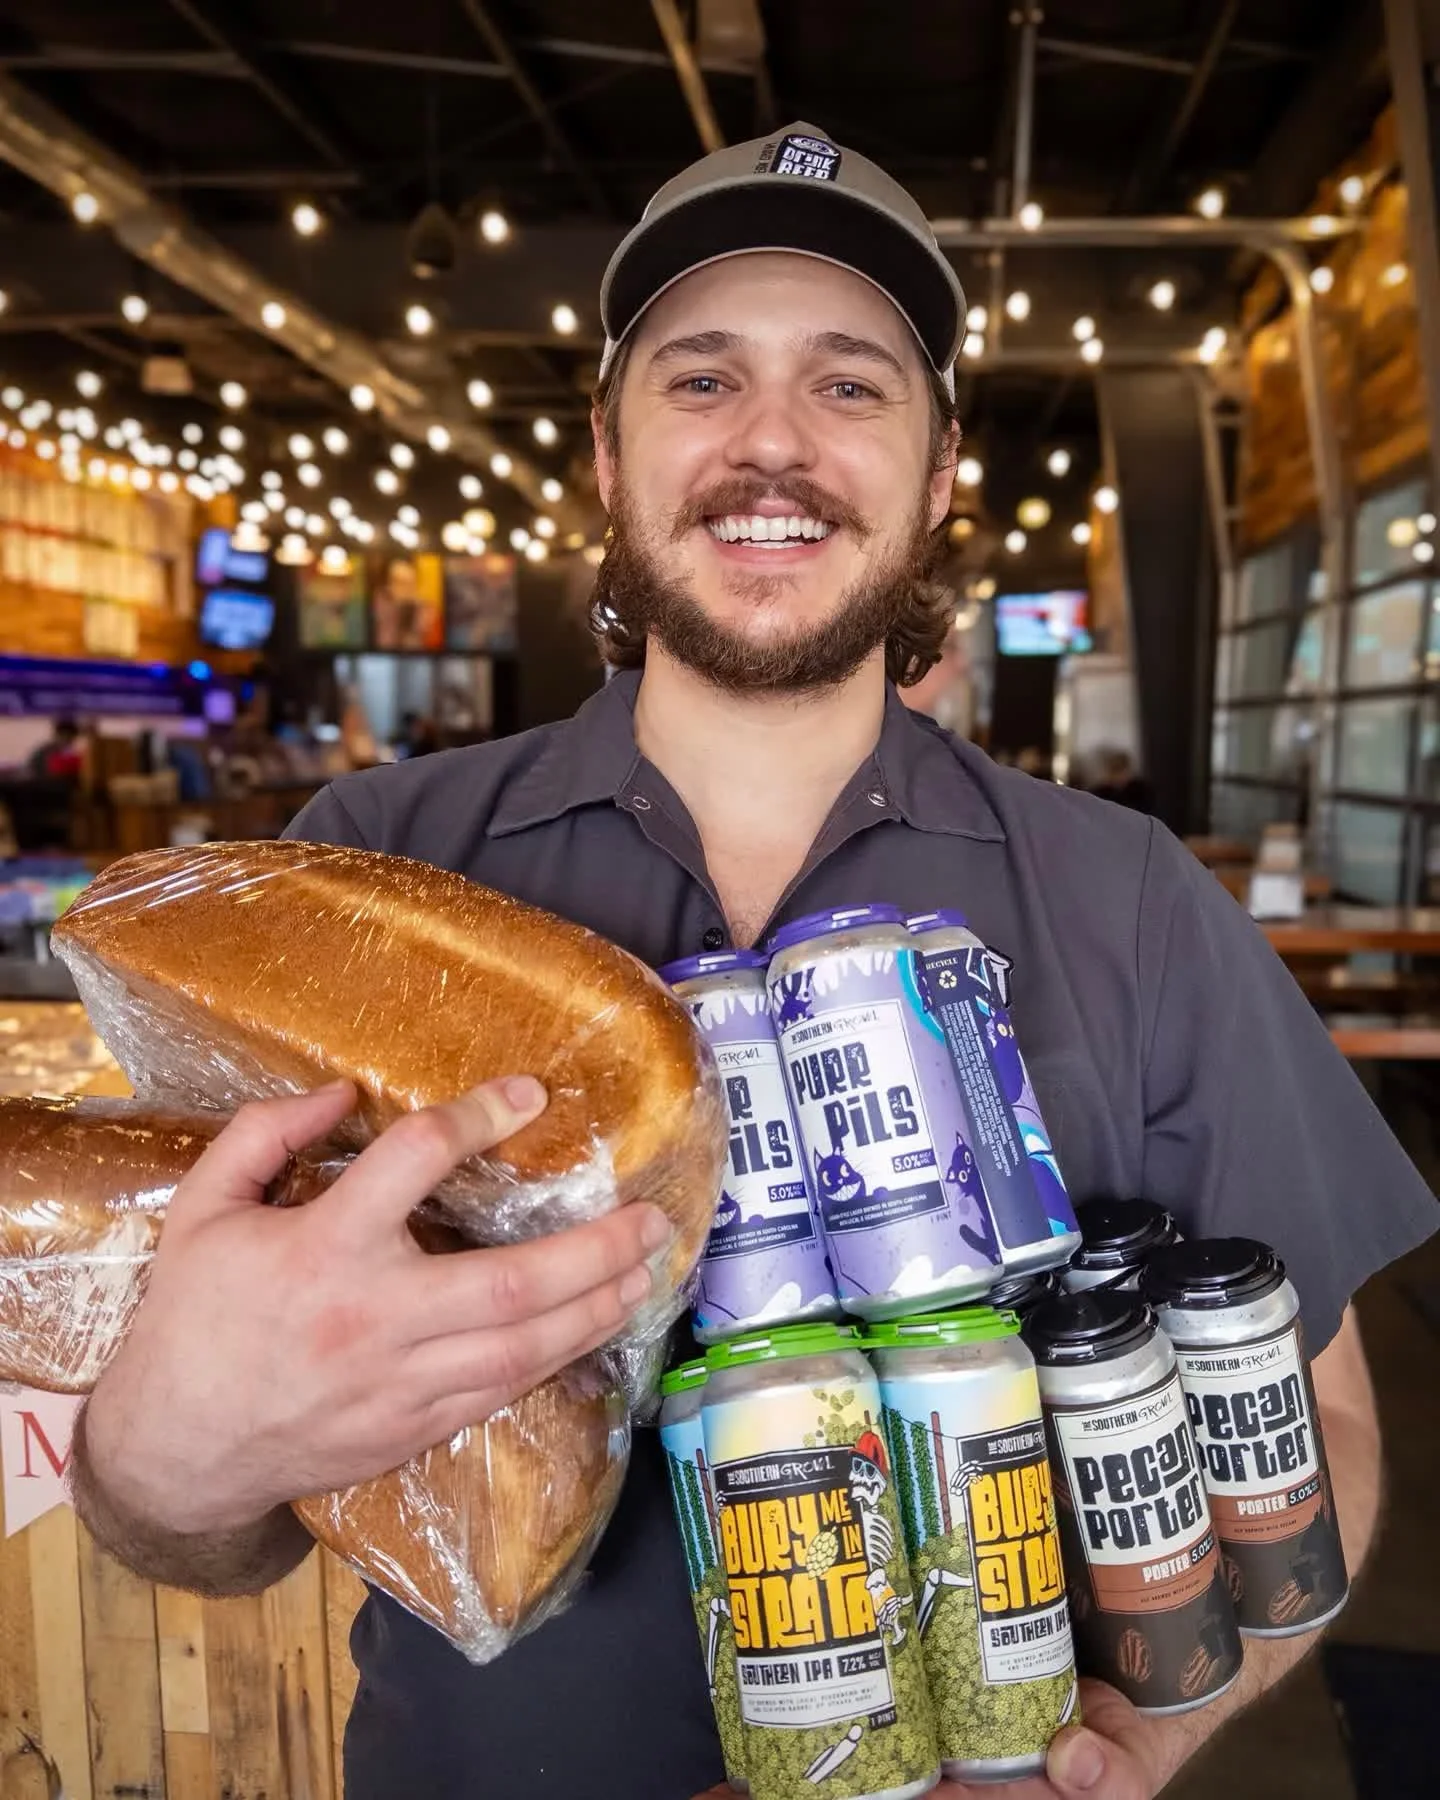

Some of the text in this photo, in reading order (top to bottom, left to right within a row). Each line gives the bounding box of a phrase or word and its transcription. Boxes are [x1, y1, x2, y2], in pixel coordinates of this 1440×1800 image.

[925, 957, 958, 971] RECYCLE
[796, 1021, 833, 1043] SOUTHERN
[789, 1041, 873, 1106] PURR
[894, 1153, 921, 1171] 5.0%
[770, 1187, 794, 1200] 5.0%
[1195, 1358, 1240, 1372] SOUTHERN
[1240, 1345, 1282, 1369] GROWL
[1092, 1410, 1138, 1431] SOUTHERN
[1138, 1392, 1174, 1421] GROWL
[997, 1433, 1034, 1454] SOUTHERN
[1034, 1432, 1046, 1448] GR
[734, 1463, 780, 1485] SOUTHERN
[780, 1455, 835, 1480] GROWL
[969, 1460, 1058, 1543] BURY
[1237, 1494, 1288, 1516] PORTER
[1289, 1484, 1312, 1504] 5.0%
[720, 1488, 852, 1574] BURY ME
[843, 1524, 864, 1560] IN
[1142, 1541, 1210, 1584] PORTER 5.0%
[728, 1560, 877, 1649] STRATA
[990, 1615, 1054, 1648] SOUTHERN
[741, 1662, 800, 1686] SOUTHERN
[804, 1658, 833, 1682] IPA
[842, 1655, 867, 1673] 7.2%
[877, 1710, 896, 1726] PINT
